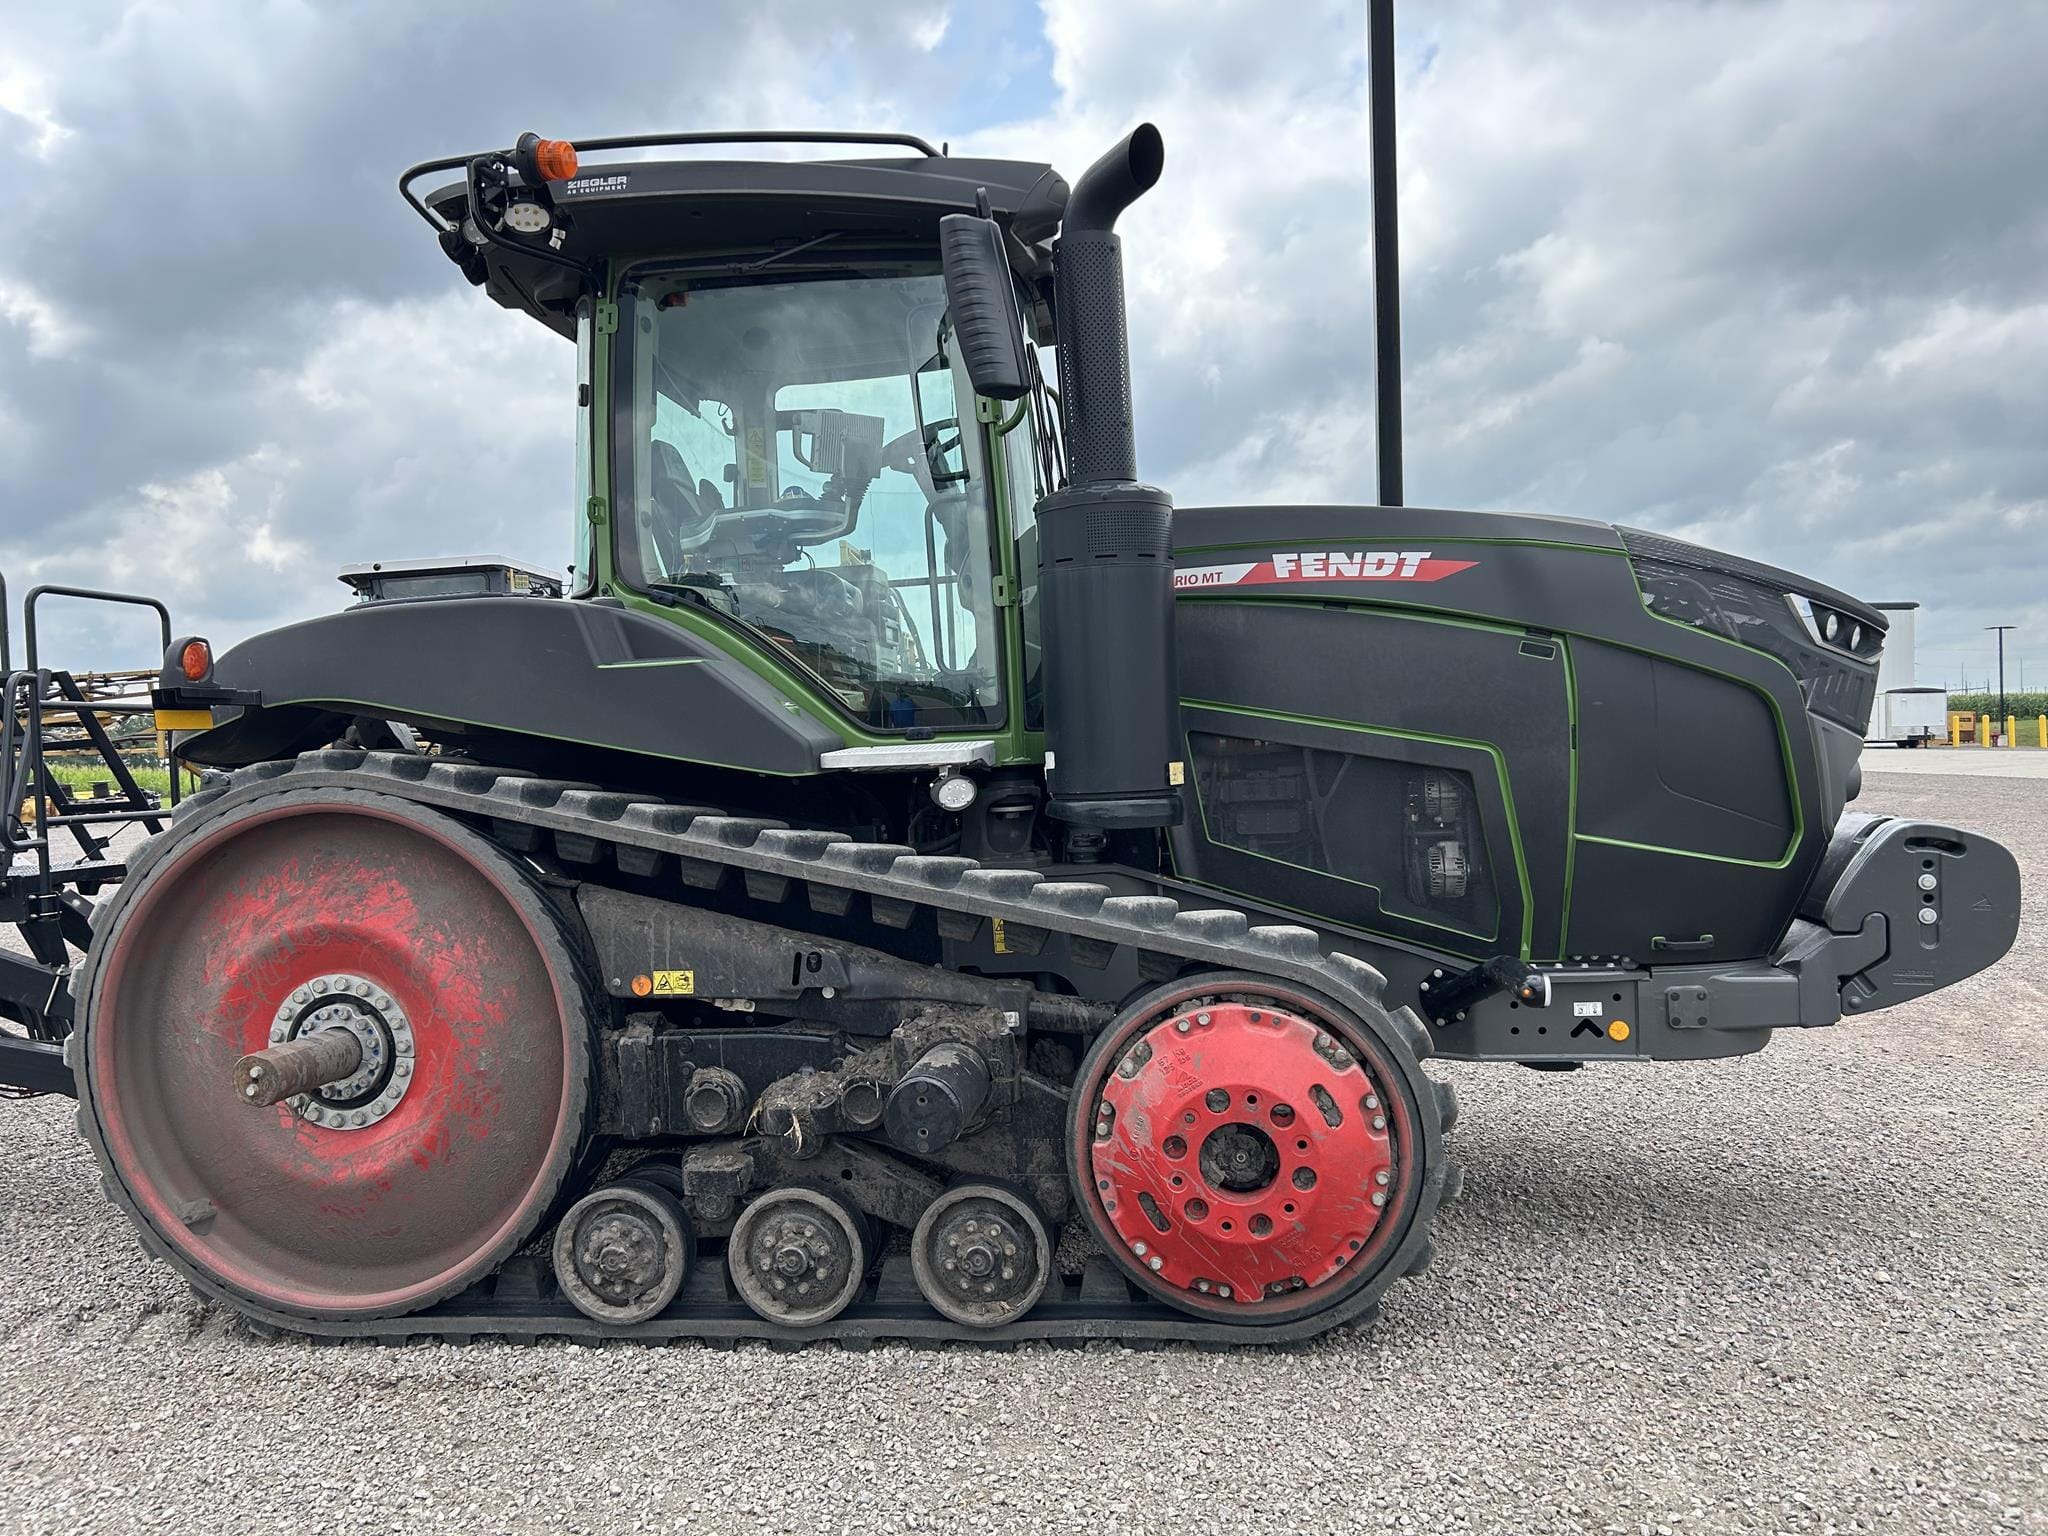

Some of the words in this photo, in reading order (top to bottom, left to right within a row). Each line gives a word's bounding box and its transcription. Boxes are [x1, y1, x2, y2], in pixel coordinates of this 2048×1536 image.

[567, 176, 627, 189] ZIEGLER
[580, 184, 627, 194] EQUIPMENT
[1271, 551, 1432, 579] FENDT
[1175, 574, 1199, 586] RIO
[1201, 571, 1224, 584] MT
